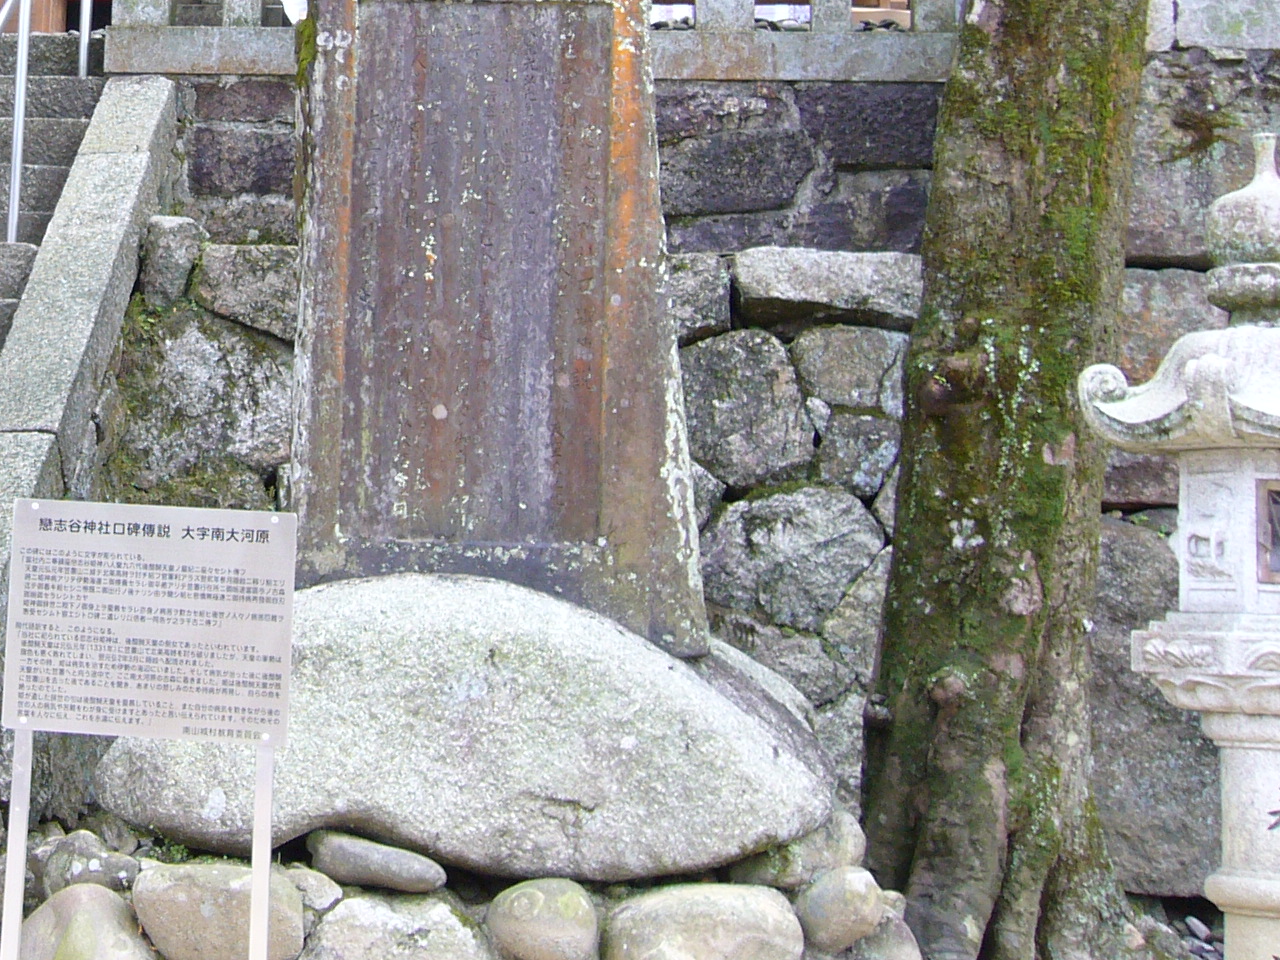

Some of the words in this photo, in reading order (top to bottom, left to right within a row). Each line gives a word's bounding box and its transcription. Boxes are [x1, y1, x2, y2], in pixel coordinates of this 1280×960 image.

[181, 525, 270, 544] 大字南大河原
